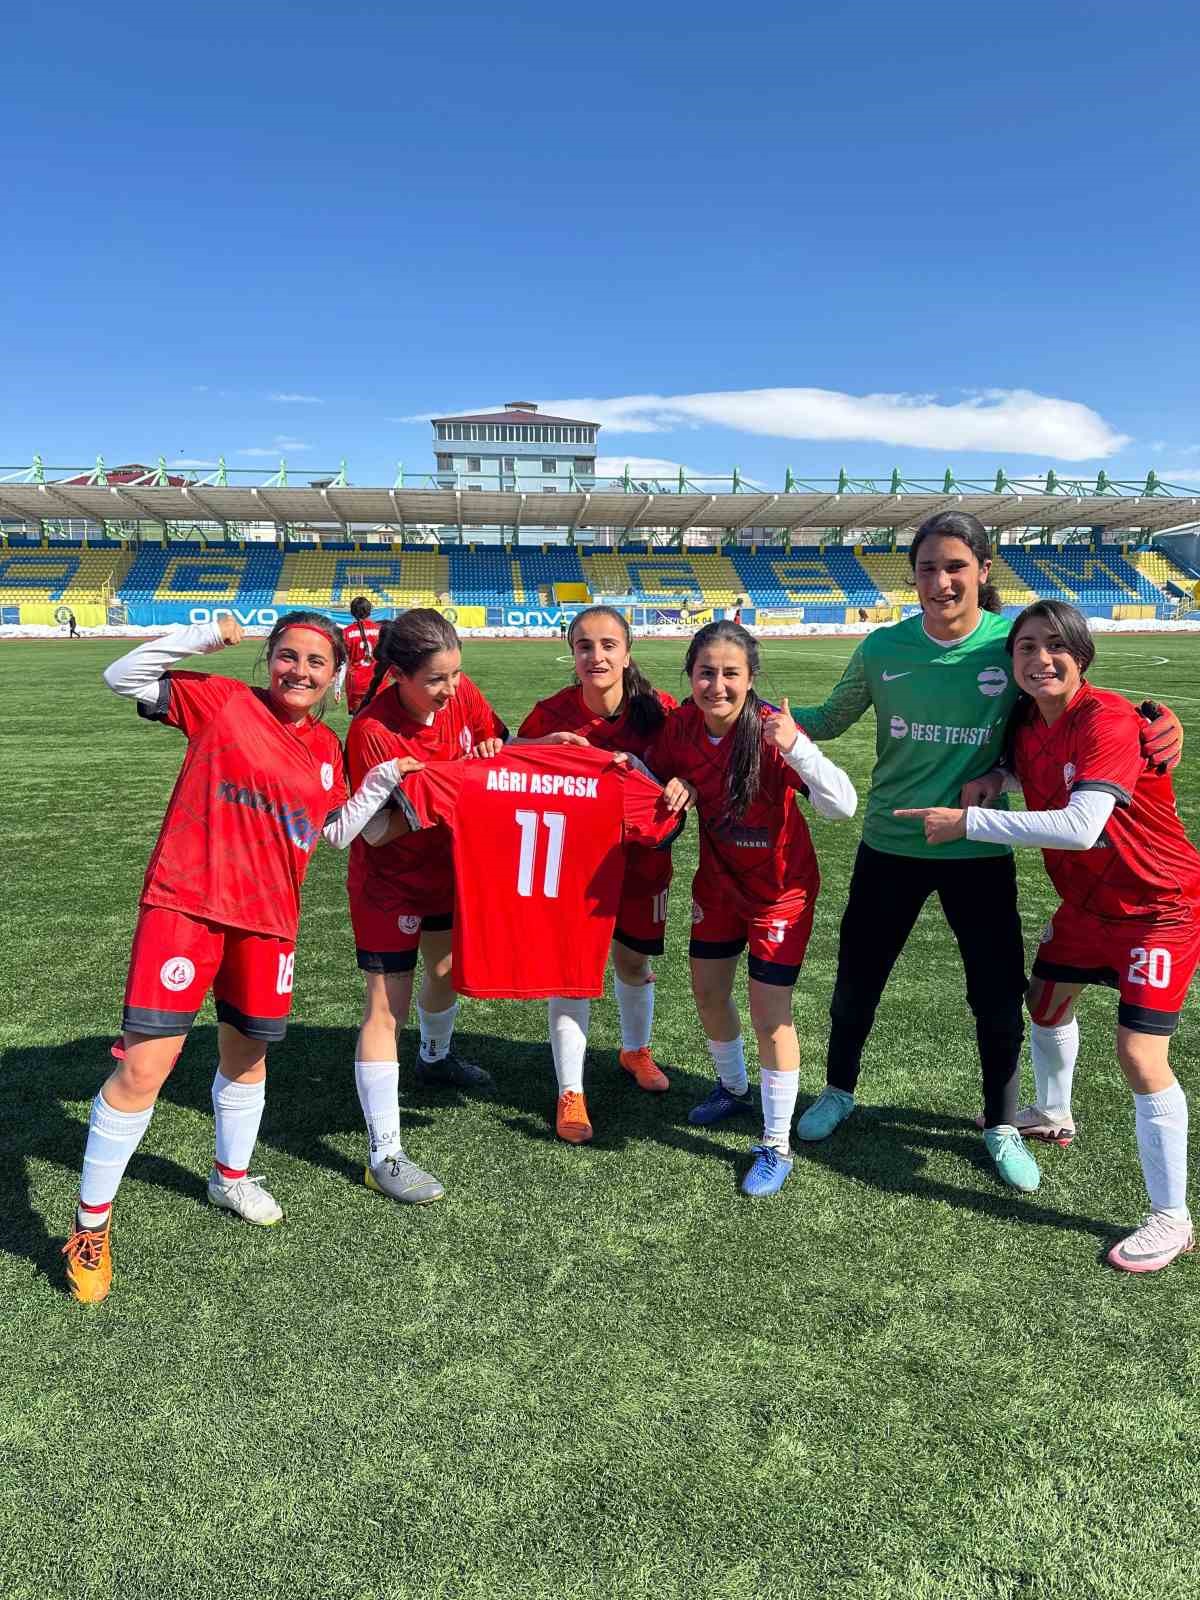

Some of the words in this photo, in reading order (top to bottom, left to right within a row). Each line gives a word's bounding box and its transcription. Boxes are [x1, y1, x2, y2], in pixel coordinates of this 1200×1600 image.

[911, 722, 942, 742] GESE
[486, 767, 527, 793] AĞRI
[530, 773, 599, 798] ASPGSK
[515, 808, 567, 898] 11
[276, 951, 295, 995] 18
[1127, 947, 1172, 989] 20
